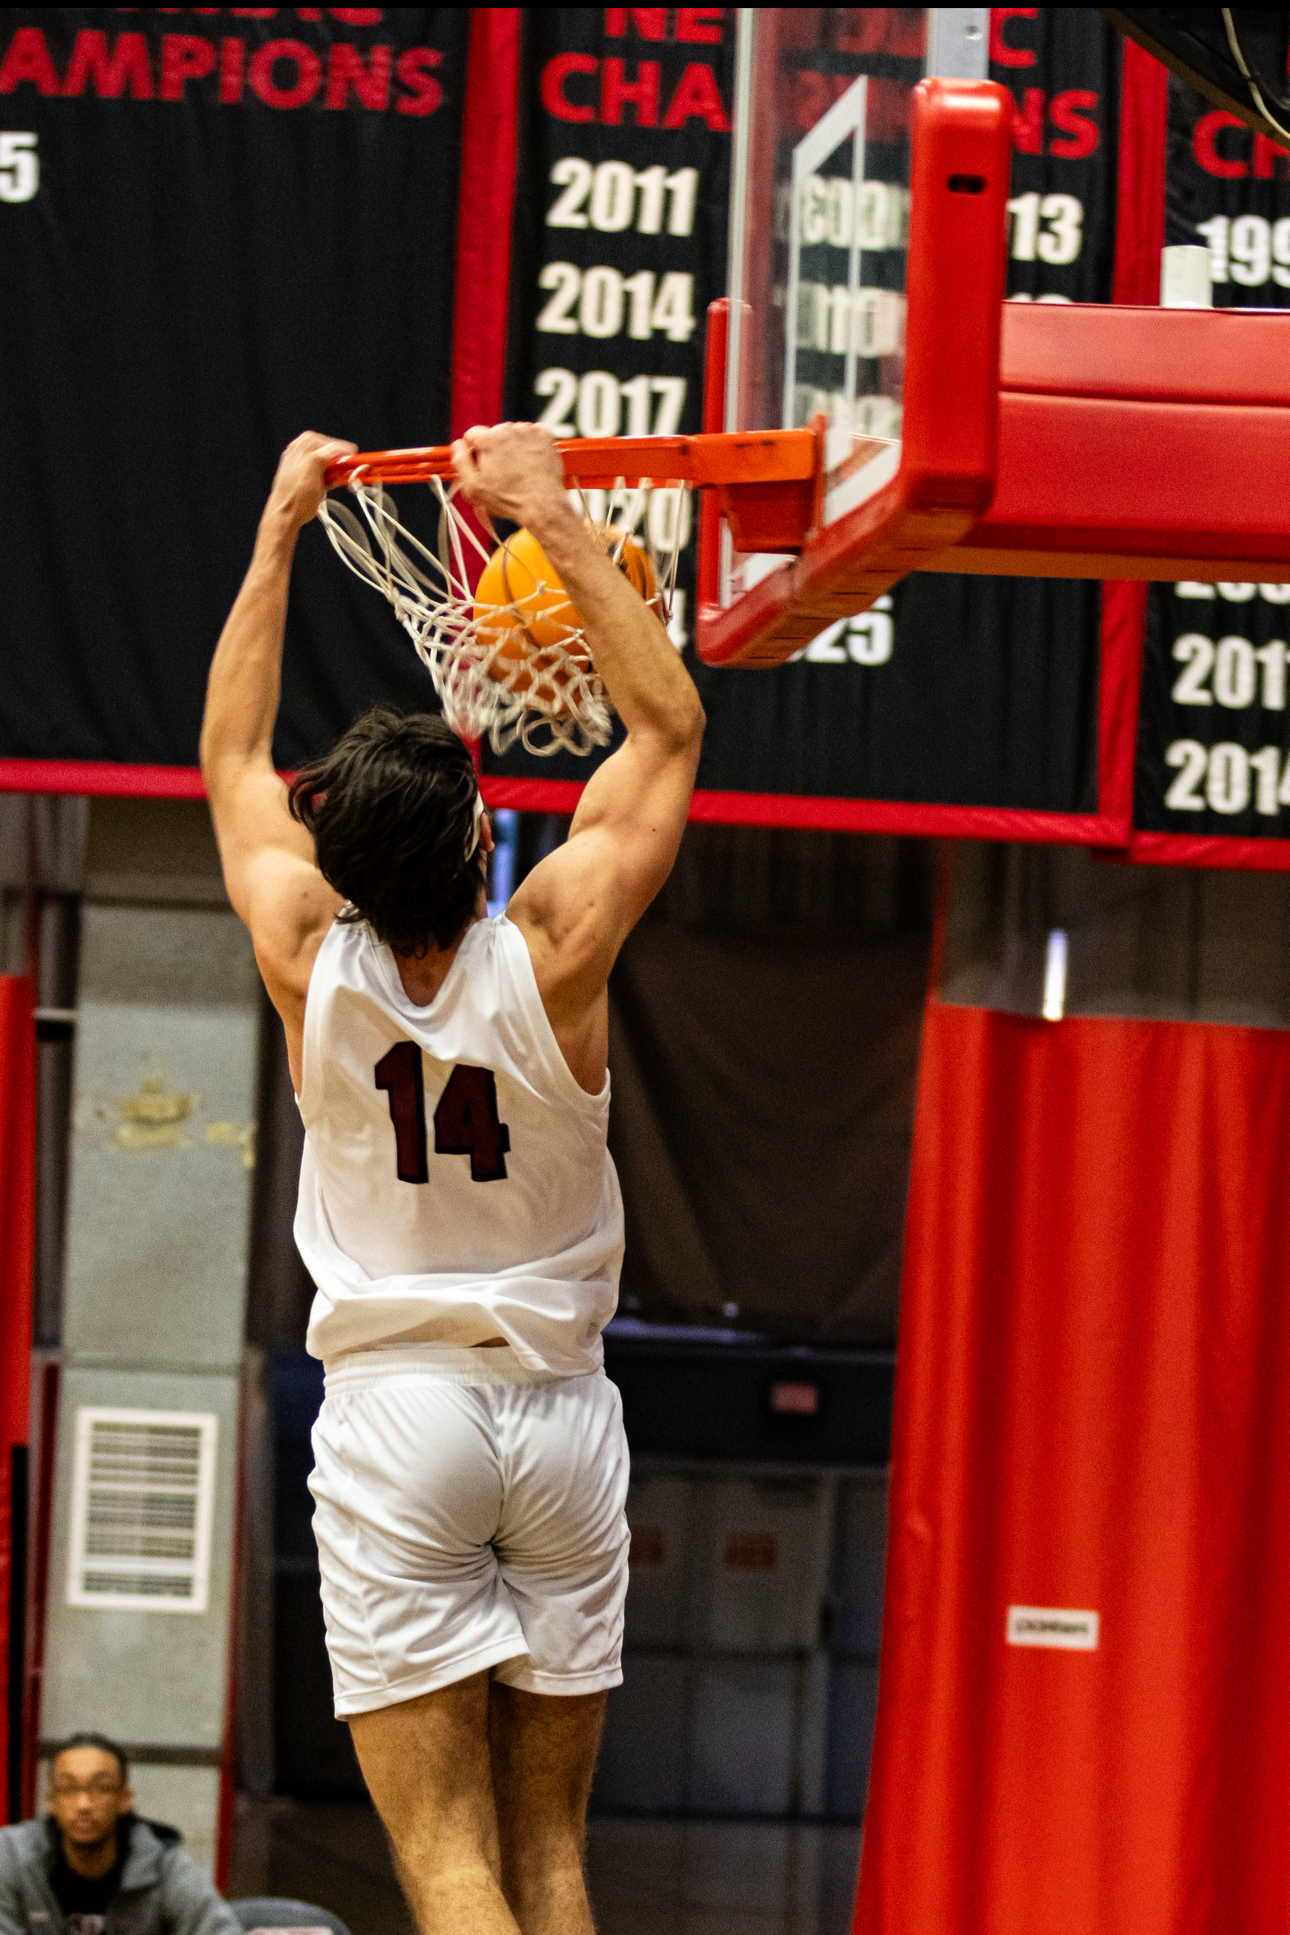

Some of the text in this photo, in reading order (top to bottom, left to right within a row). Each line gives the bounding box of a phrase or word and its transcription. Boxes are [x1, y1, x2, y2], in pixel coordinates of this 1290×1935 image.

[0, 28, 443, 117] AMPIONS
[546, 157, 698, 237] 2011
[1007, 191, 1085, 265] 13
[535, 261, 696, 343] 2014
[534, 367, 687, 438] 2017
[1172, 633, 1290, 711] 201
[1165, 738, 1290, 816] 201
[374, 1040, 511, 1184] 14
